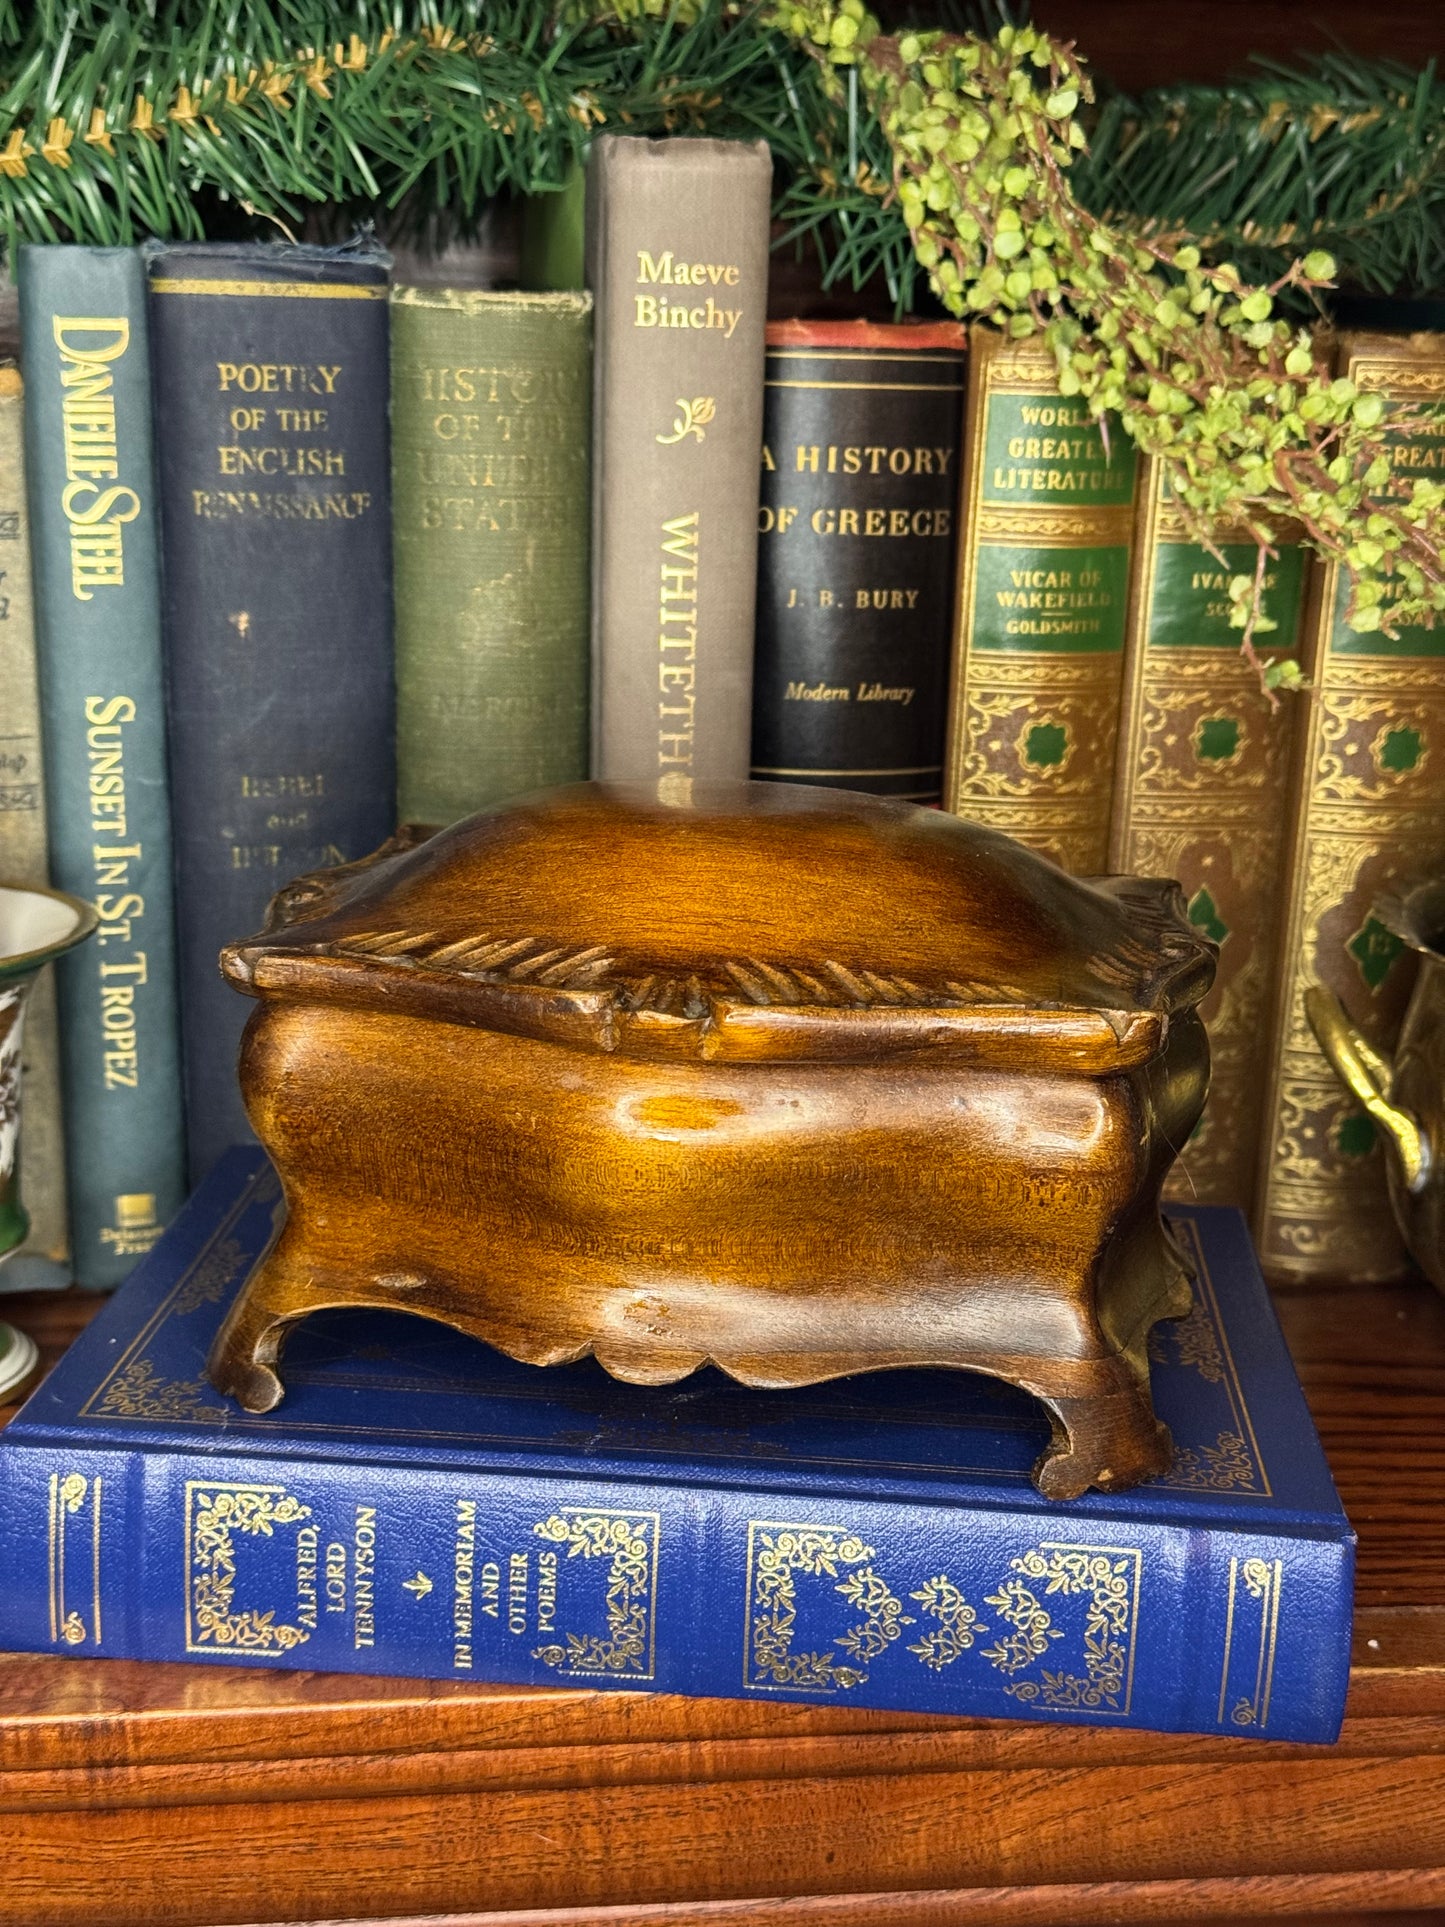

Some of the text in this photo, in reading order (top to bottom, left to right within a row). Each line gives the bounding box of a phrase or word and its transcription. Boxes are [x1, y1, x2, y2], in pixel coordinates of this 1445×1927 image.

[636, 251, 741, 287] Maeve
[634, 294, 743, 339] Binchy
[230, 407, 329, 432] OF THE
[434, 413, 480, 440] OF
[1021, 406, 1090, 428] WORL
[794, 446, 952, 475] HISTORY
[993, 467, 1126, 492] LITERATURE
[757, 506, 950, 537] OF GREECE
[61, 479, 141, 601] STEEL
[1010, 570, 1102, 589] VICAR OF
[787, 589, 920, 609] J. B. BURY
[996, 590, 1110, 610] WAKEFIELD
[1006, 619, 1100, 636] GOLDSMITH
[656, 512, 700, 790] WHITETH
[784, 682, 915, 706] Modern Library
[84, 695, 148, 1091] SUNSET IN ST. TROPEZ
[297, 1524, 322, 1630] ALFRED,
[325, 1542, 347, 1613] LORD
[354, 1504, 377, 1650] TENNYSON
[454, 1498, 478, 1670] IN MEMORIAM
[481, 1562, 500, 1618] AND
[508, 1552, 530, 1635] OTHER
[537, 1551, 559, 1633] POEMS
